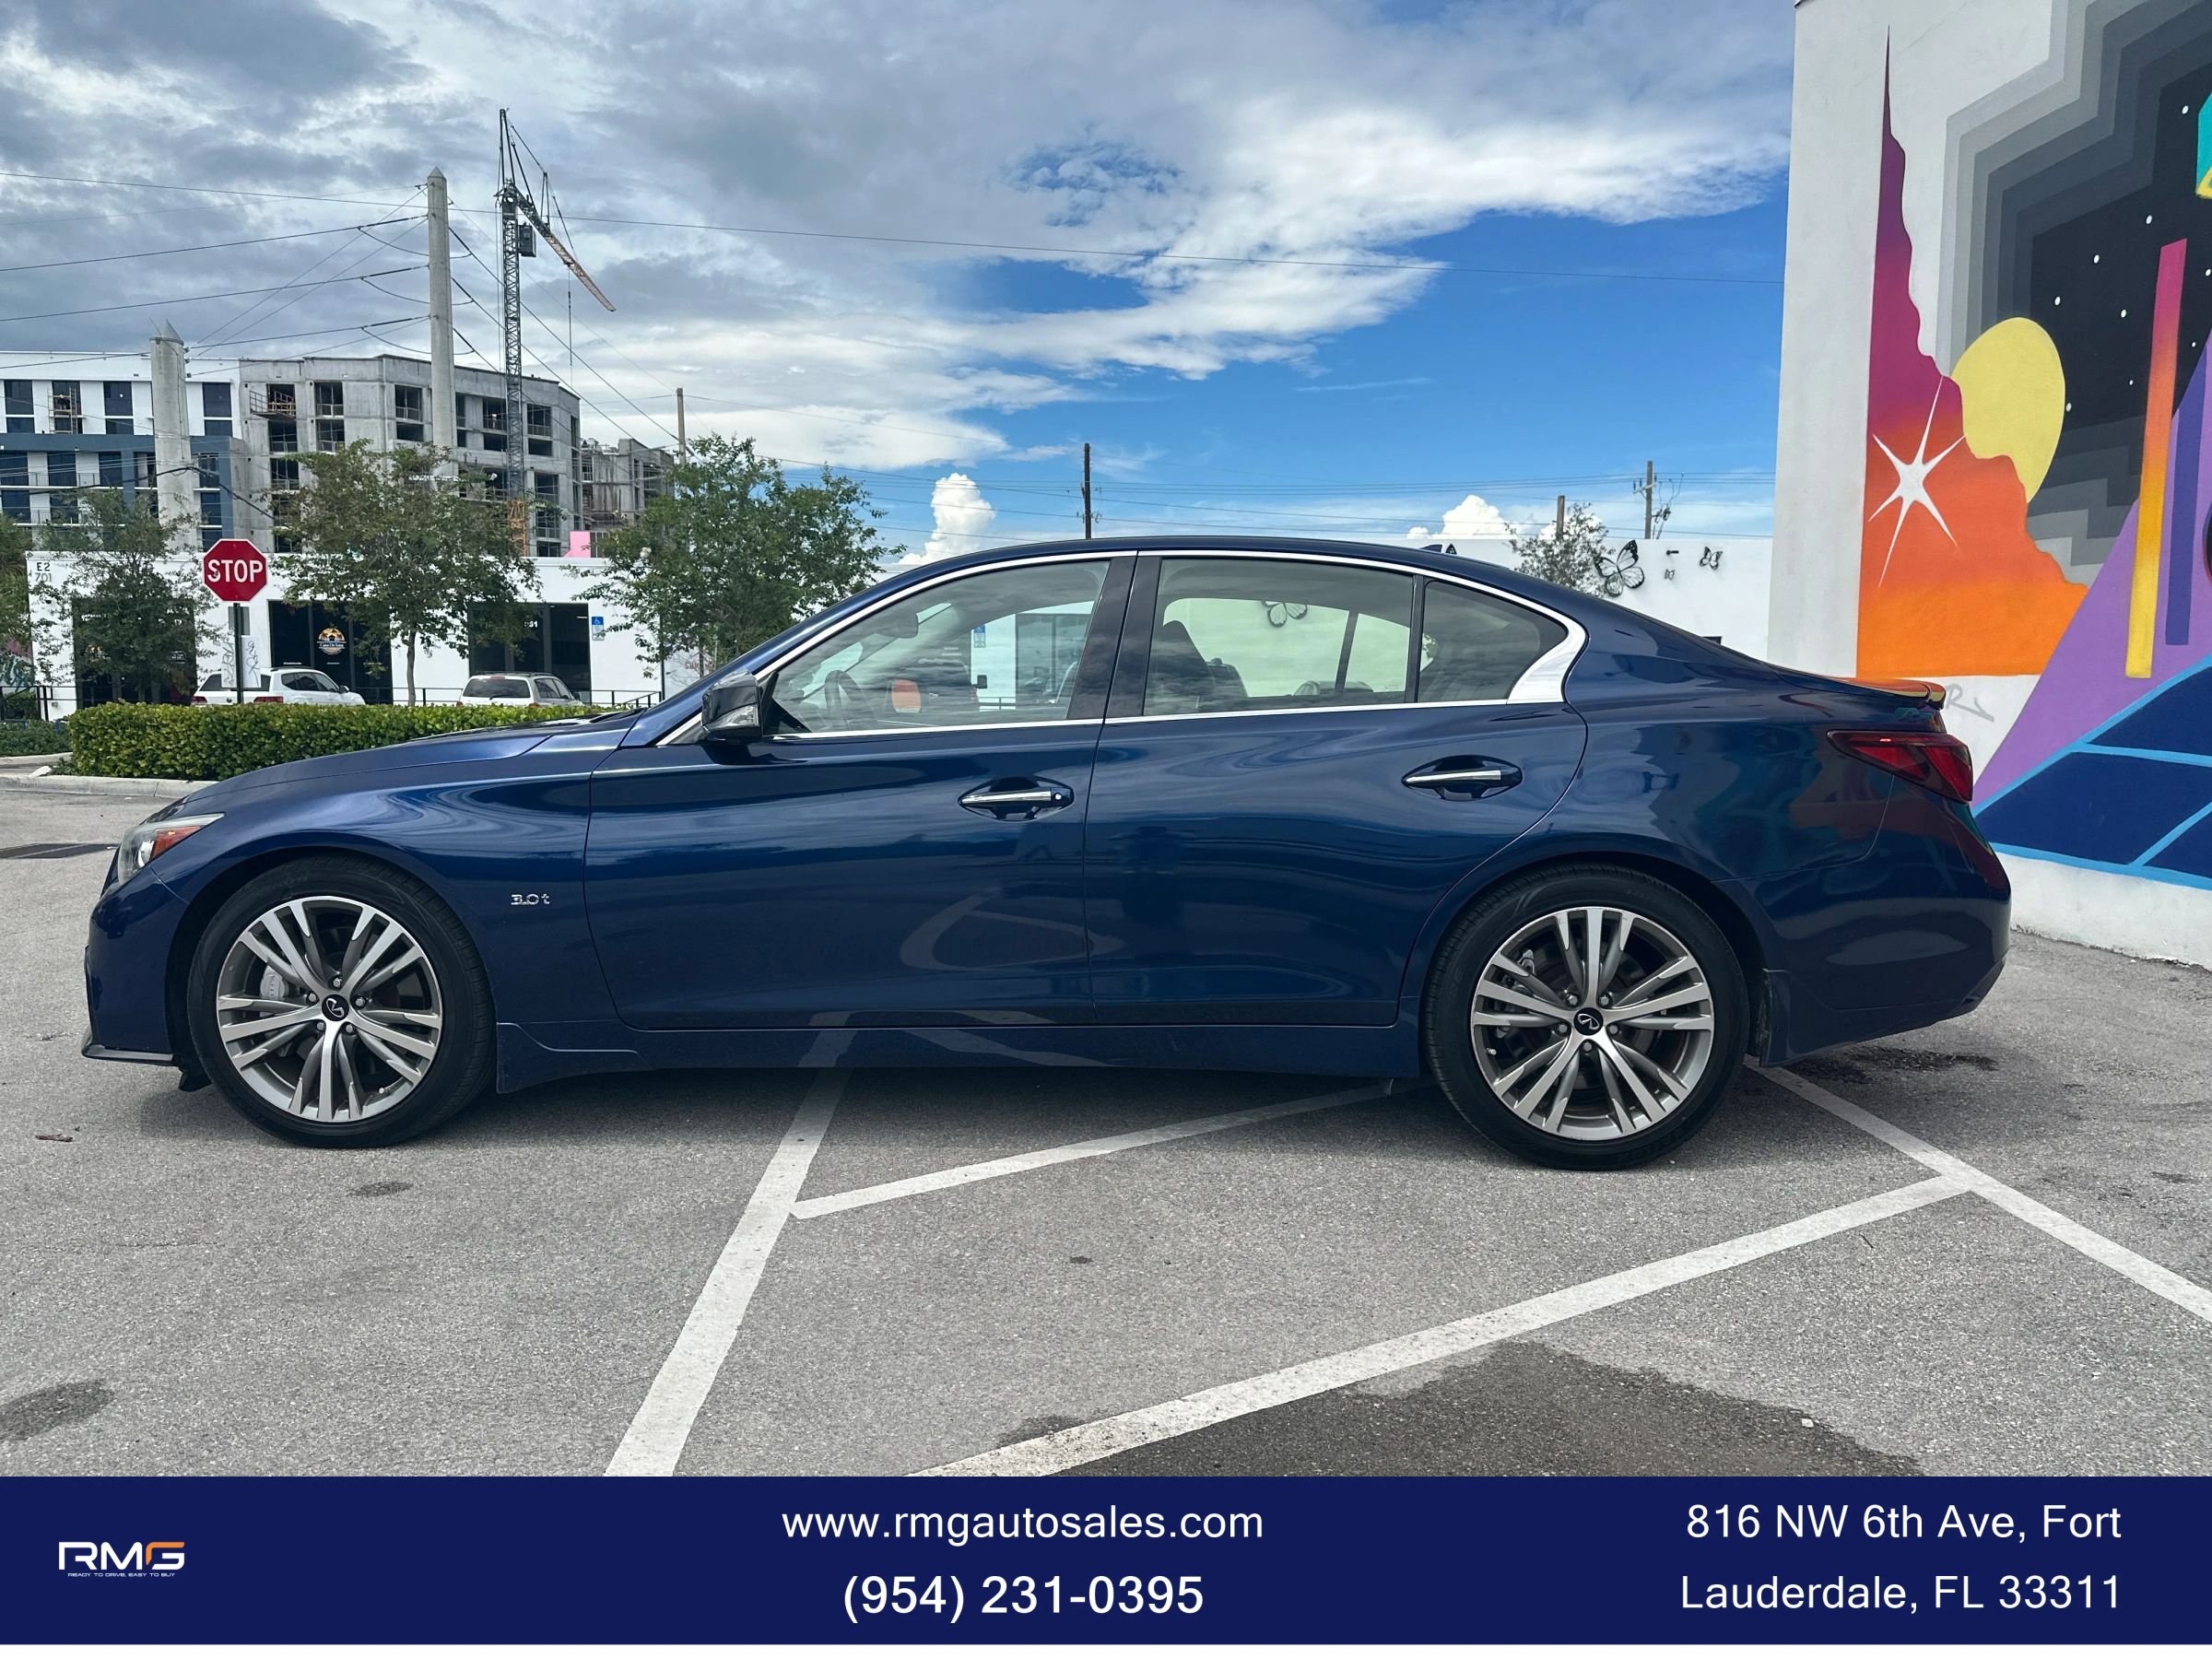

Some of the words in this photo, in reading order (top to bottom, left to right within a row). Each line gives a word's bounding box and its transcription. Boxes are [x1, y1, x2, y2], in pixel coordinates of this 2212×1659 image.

[36, 561, 51, 571] E2
[207, 559, 264, 582] STOP
[35, 572, 53, 582] 701
